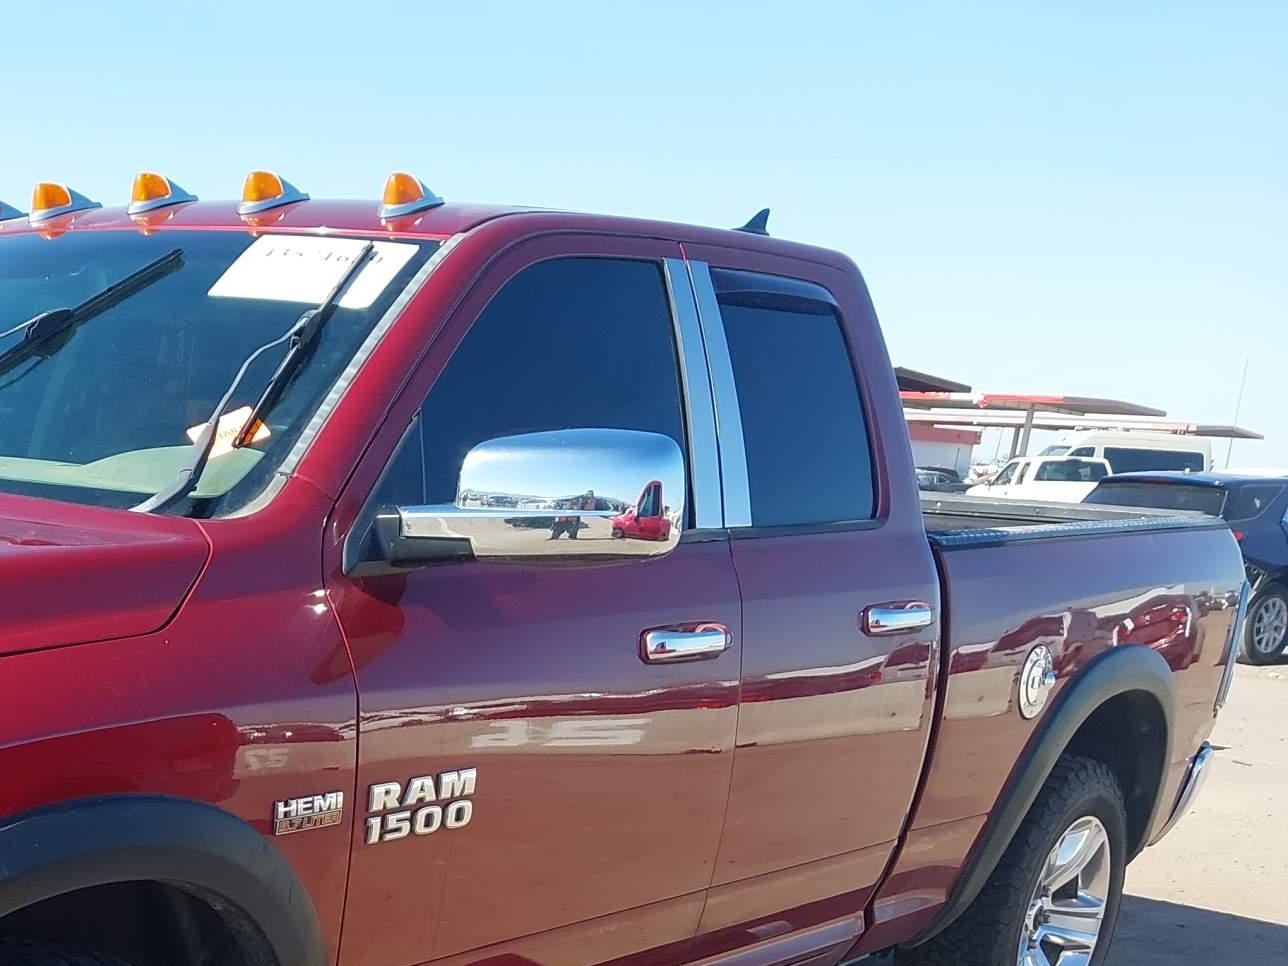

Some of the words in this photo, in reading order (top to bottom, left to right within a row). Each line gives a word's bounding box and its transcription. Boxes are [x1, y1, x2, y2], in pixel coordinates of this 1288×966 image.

[275, 791, 344, 819] HEMI
[368, 767, 477, 813] RAM
[302, 811, 340, 829] LITER
[366, 800, 473, 845] 1500
